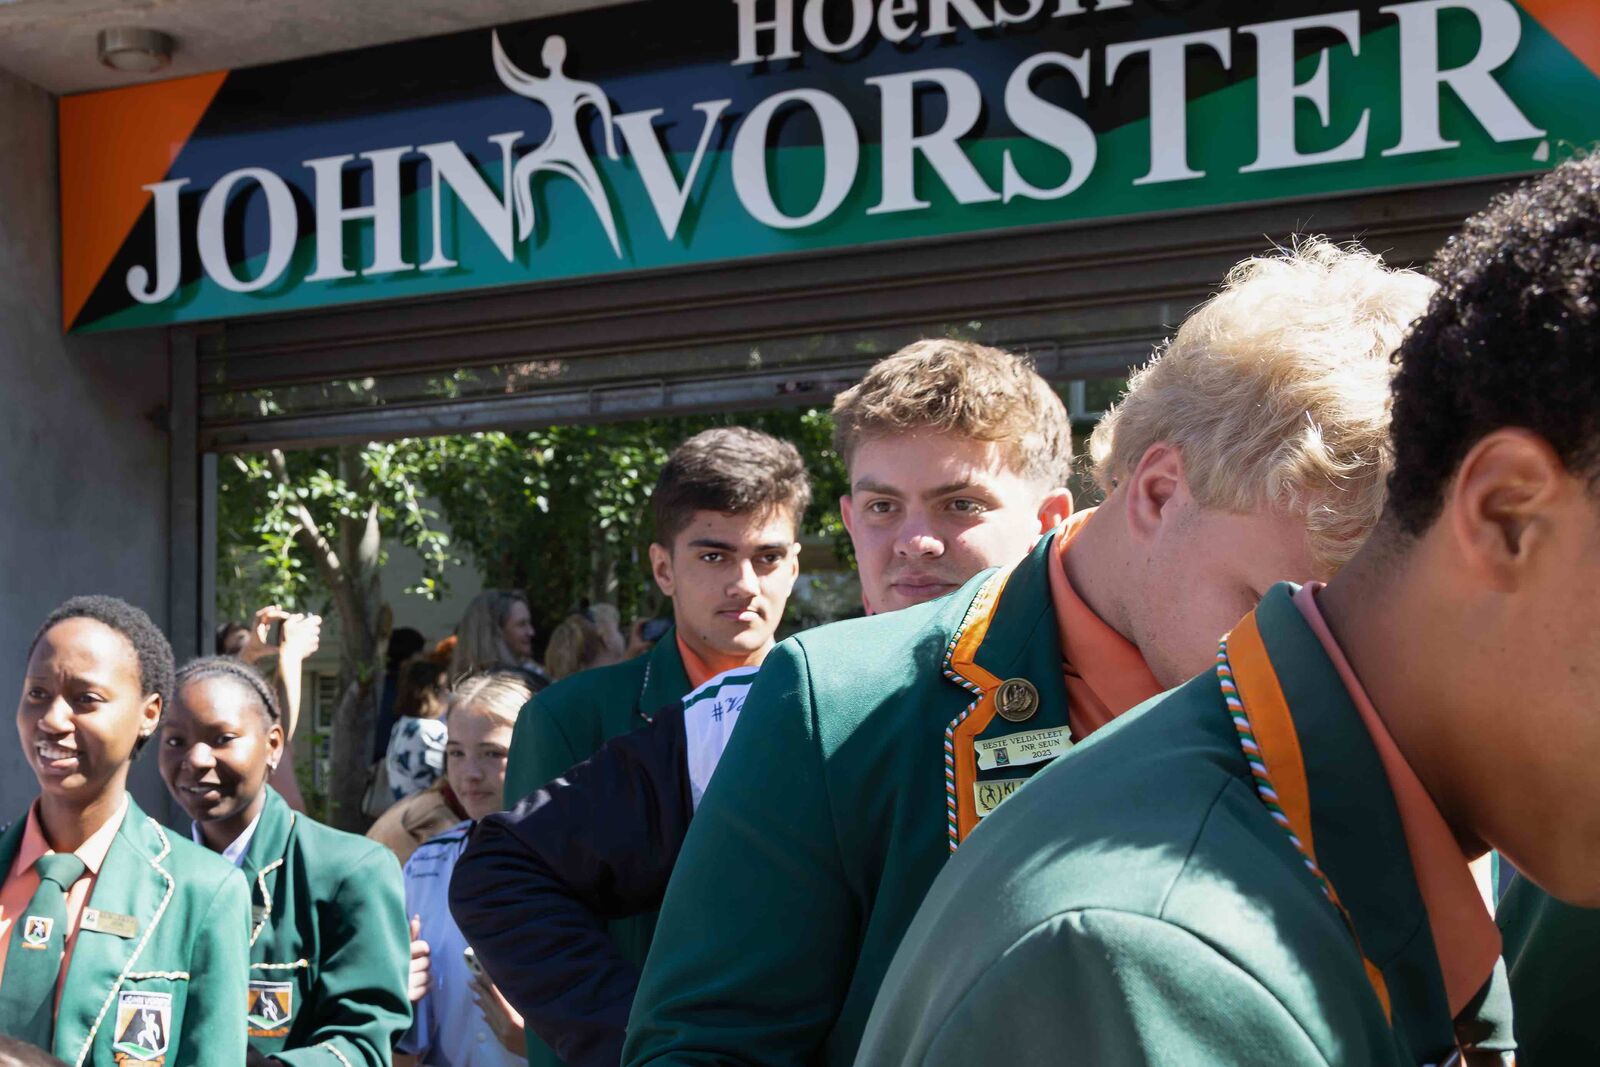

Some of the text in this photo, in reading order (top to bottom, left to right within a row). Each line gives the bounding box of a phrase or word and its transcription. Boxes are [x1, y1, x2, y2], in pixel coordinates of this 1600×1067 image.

[125, 0, 1547, 305] JOHN VORSTER
[982, 729, 1063, 750] BESTE VELDATLEET
[1019, 739, 1060, 752] JNR SEUN
[1032, 749, 1052, 758] 2023
